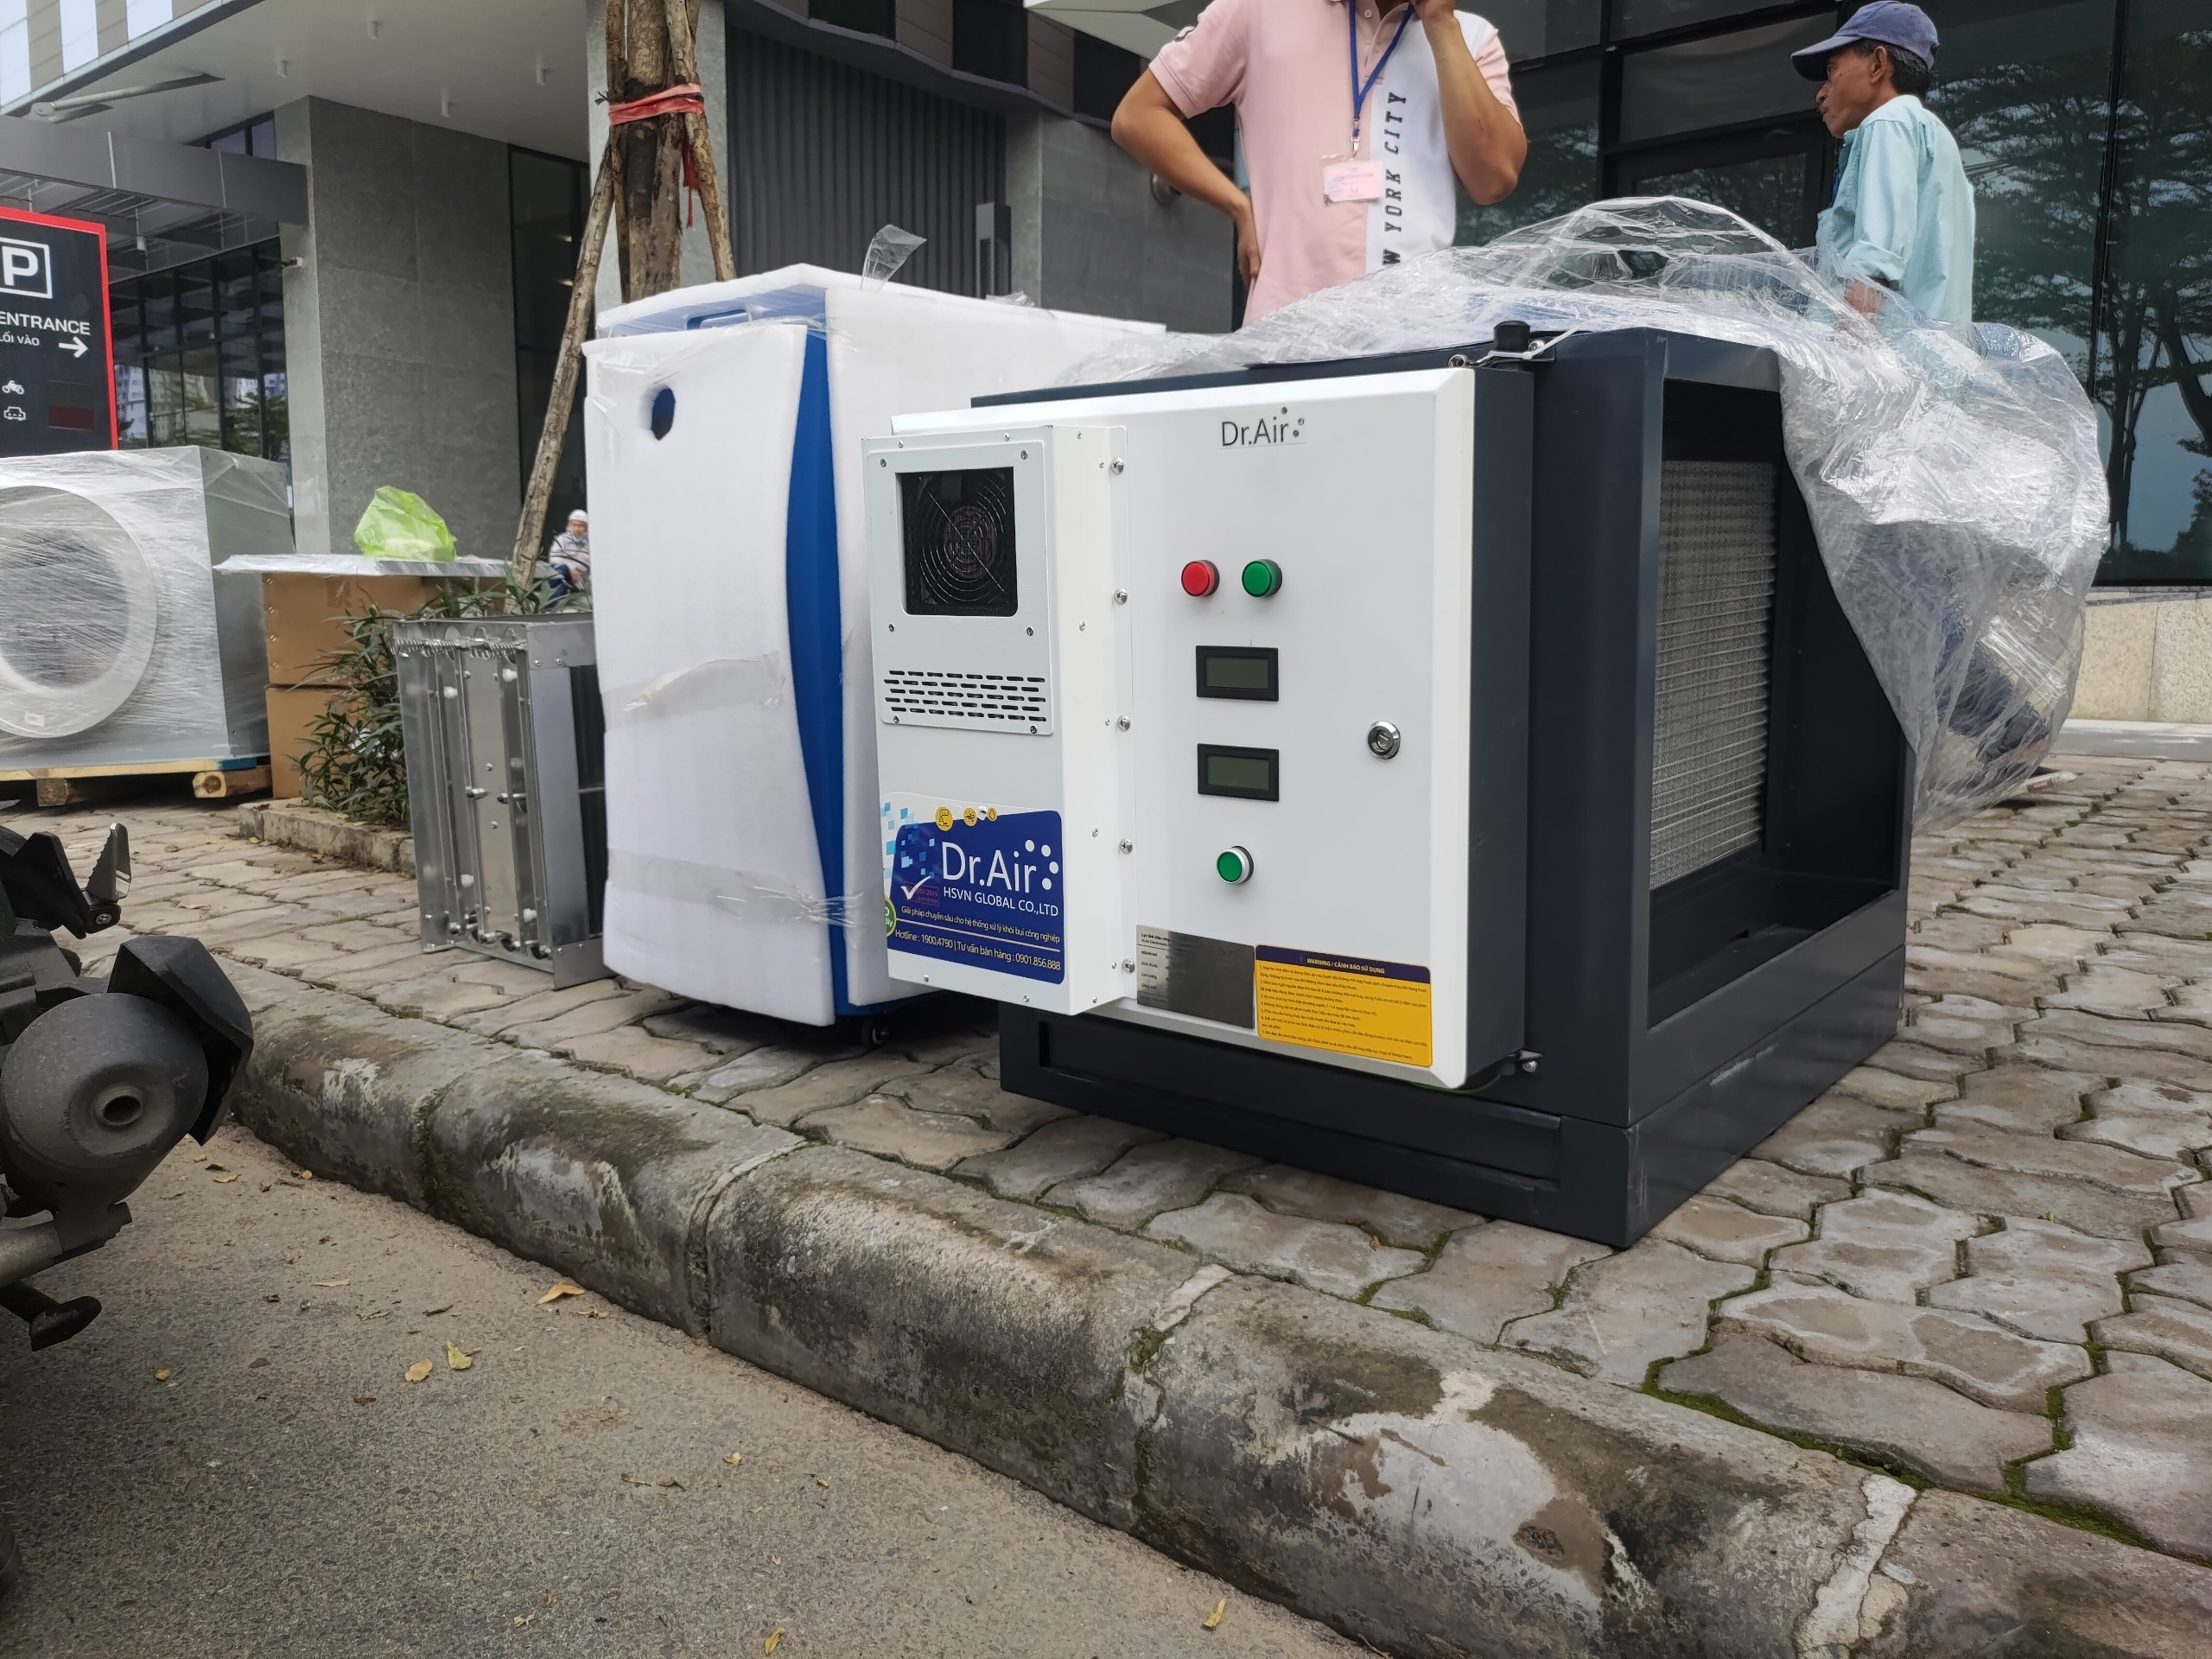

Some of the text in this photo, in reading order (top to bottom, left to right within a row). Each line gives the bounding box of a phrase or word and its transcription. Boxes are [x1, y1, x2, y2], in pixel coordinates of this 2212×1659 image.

[1384, 92, 1407, 155] CITY
[1384, 169, 1402, 232] YORK
[2, 245, 39, 286] P
[0, 311, 92, 335] ENTRANCE
[16, 334, 40, 346] VÀO
[1221, 416, 1289, 447] Dr.Air
[942, 841, 1037, 893] Dr.Air
[912, 908, 925, 918] pháp
[954, 916, 964, 925] cho
[944, 887, 1058, 916] HSVN GLOBAL CO.,LTD
[895, 928, 918, 941] Hotline
[921, 934, 953, 949] 1900.4790
[957, 941, 967, 951] Tư
[980, 945, 993, 957] bán
[994, 947, 1012, 963] hàng
[1015, 952, 1061, 970] 0901.856.888
[1306, 957, 1331, 967] WARNING
